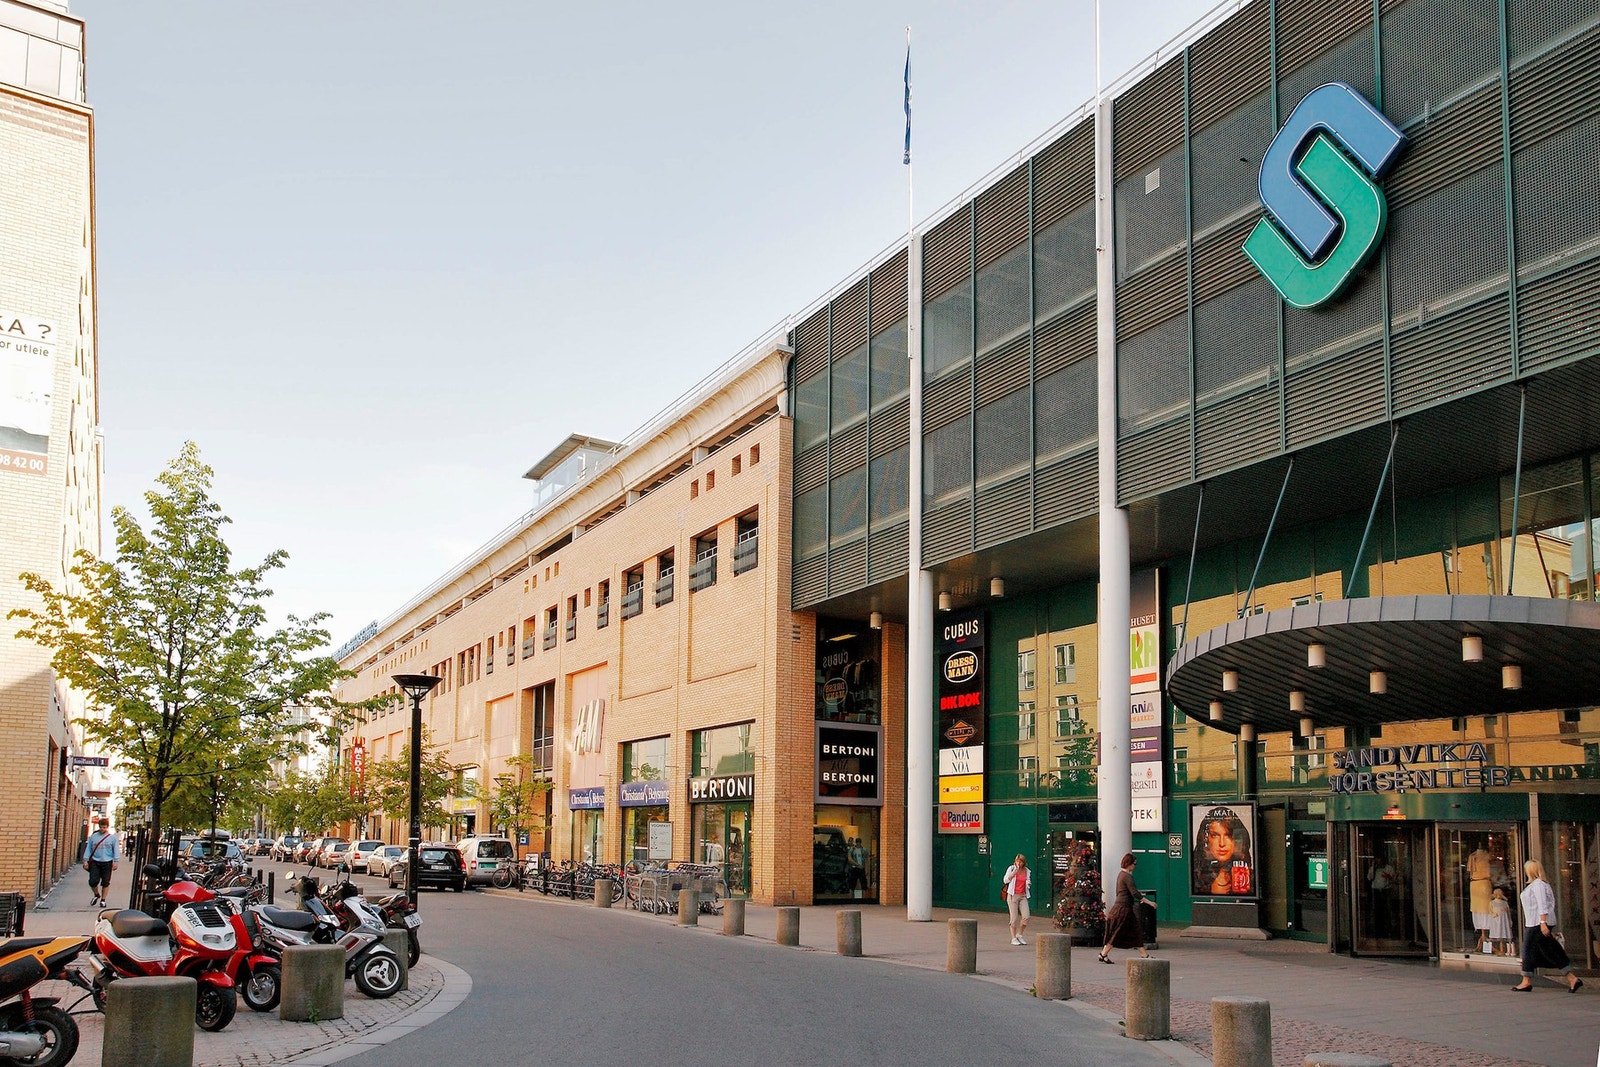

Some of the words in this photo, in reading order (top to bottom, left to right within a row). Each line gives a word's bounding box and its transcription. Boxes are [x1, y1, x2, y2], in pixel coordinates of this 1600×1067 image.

[15, 344, 49, 357] utleie
[13, 456, 27, 469] 42
[29, 458, 44, 471] 00
[1130, 613, 1156, 627] HUSET
[944, 619, 979, 641] CUBUS
[948, 655, 975, 669] DRESS
[947, 664, 974, 679] MANN
[940, 695, 958, 711] BIK
[958, 691, 981, 708] BOK
[574, 698, 605, 756] H&M
[822, 744, 875, 757] BERTONI
[951, 749, 970, 760] NOA
[1333, 743, 1488, 769] SANDVIKA
[951, 761, 970, 773] NOA
[822, 772, 875, 784] BERTONI
[692, 776, 753, 799] BERTONI
[947, 811, 980, 822] Panduro
